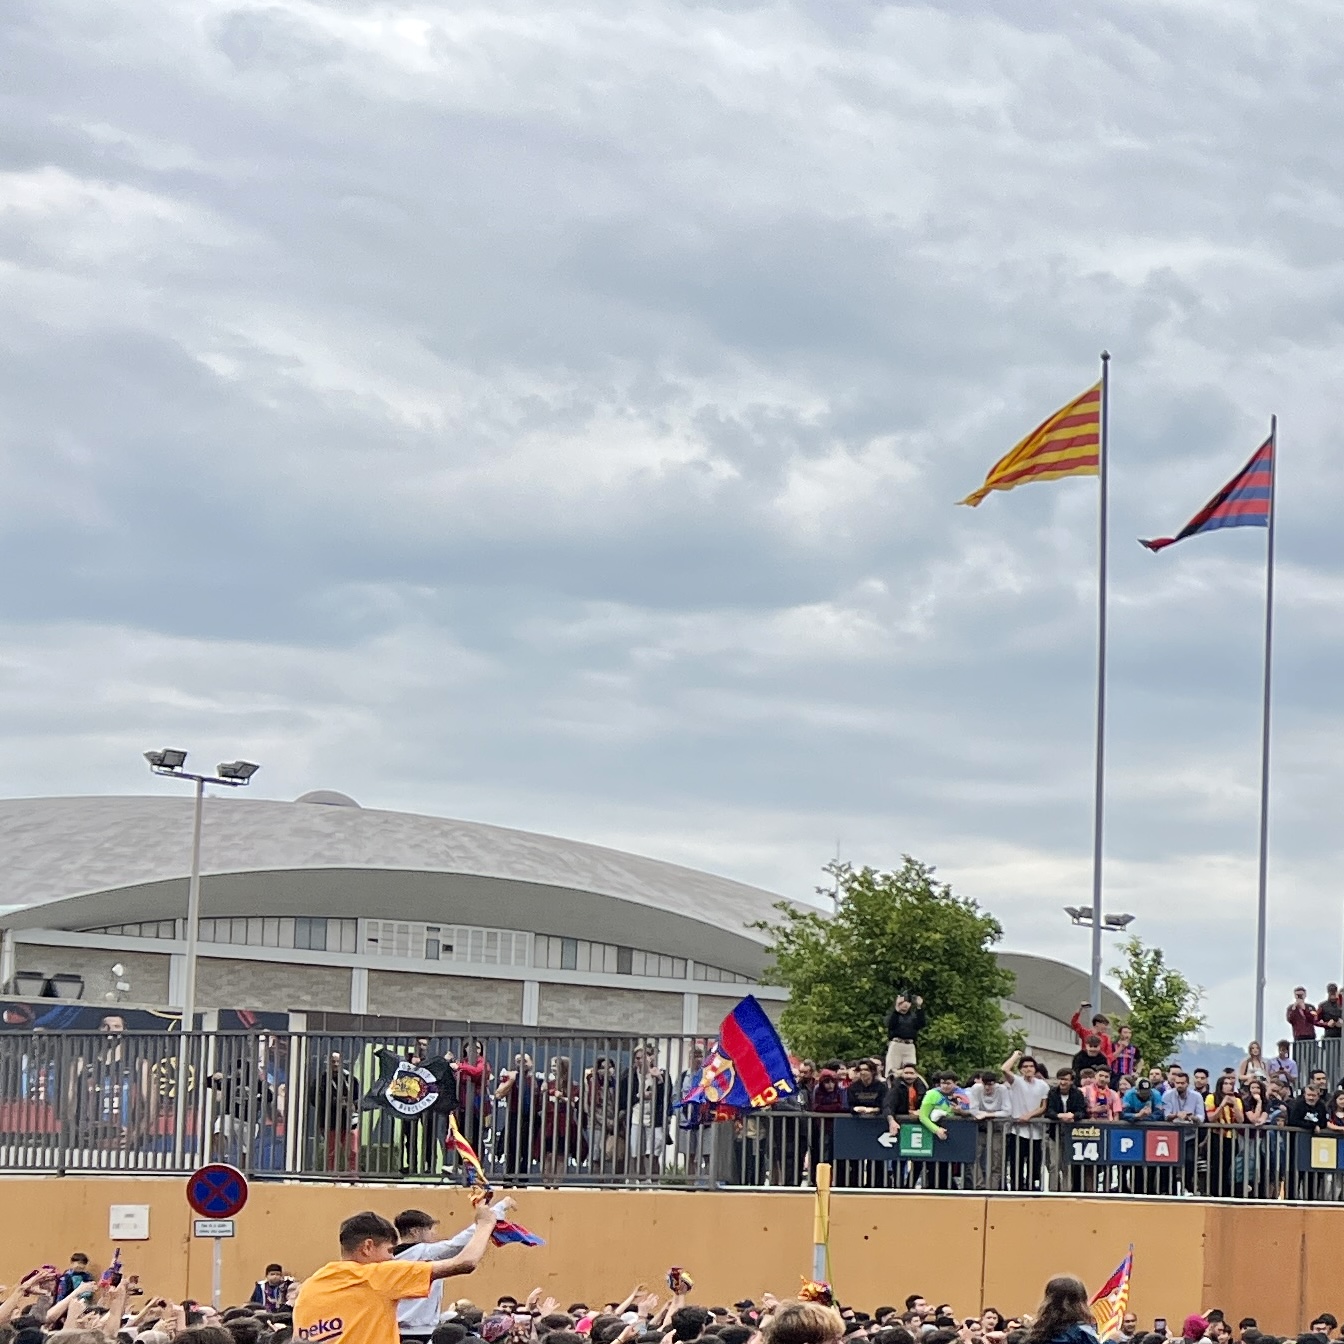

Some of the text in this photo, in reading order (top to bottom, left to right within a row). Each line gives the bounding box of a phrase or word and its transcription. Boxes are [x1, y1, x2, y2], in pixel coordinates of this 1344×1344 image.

[1072, 1137, 1170, 1161] 14 P A
